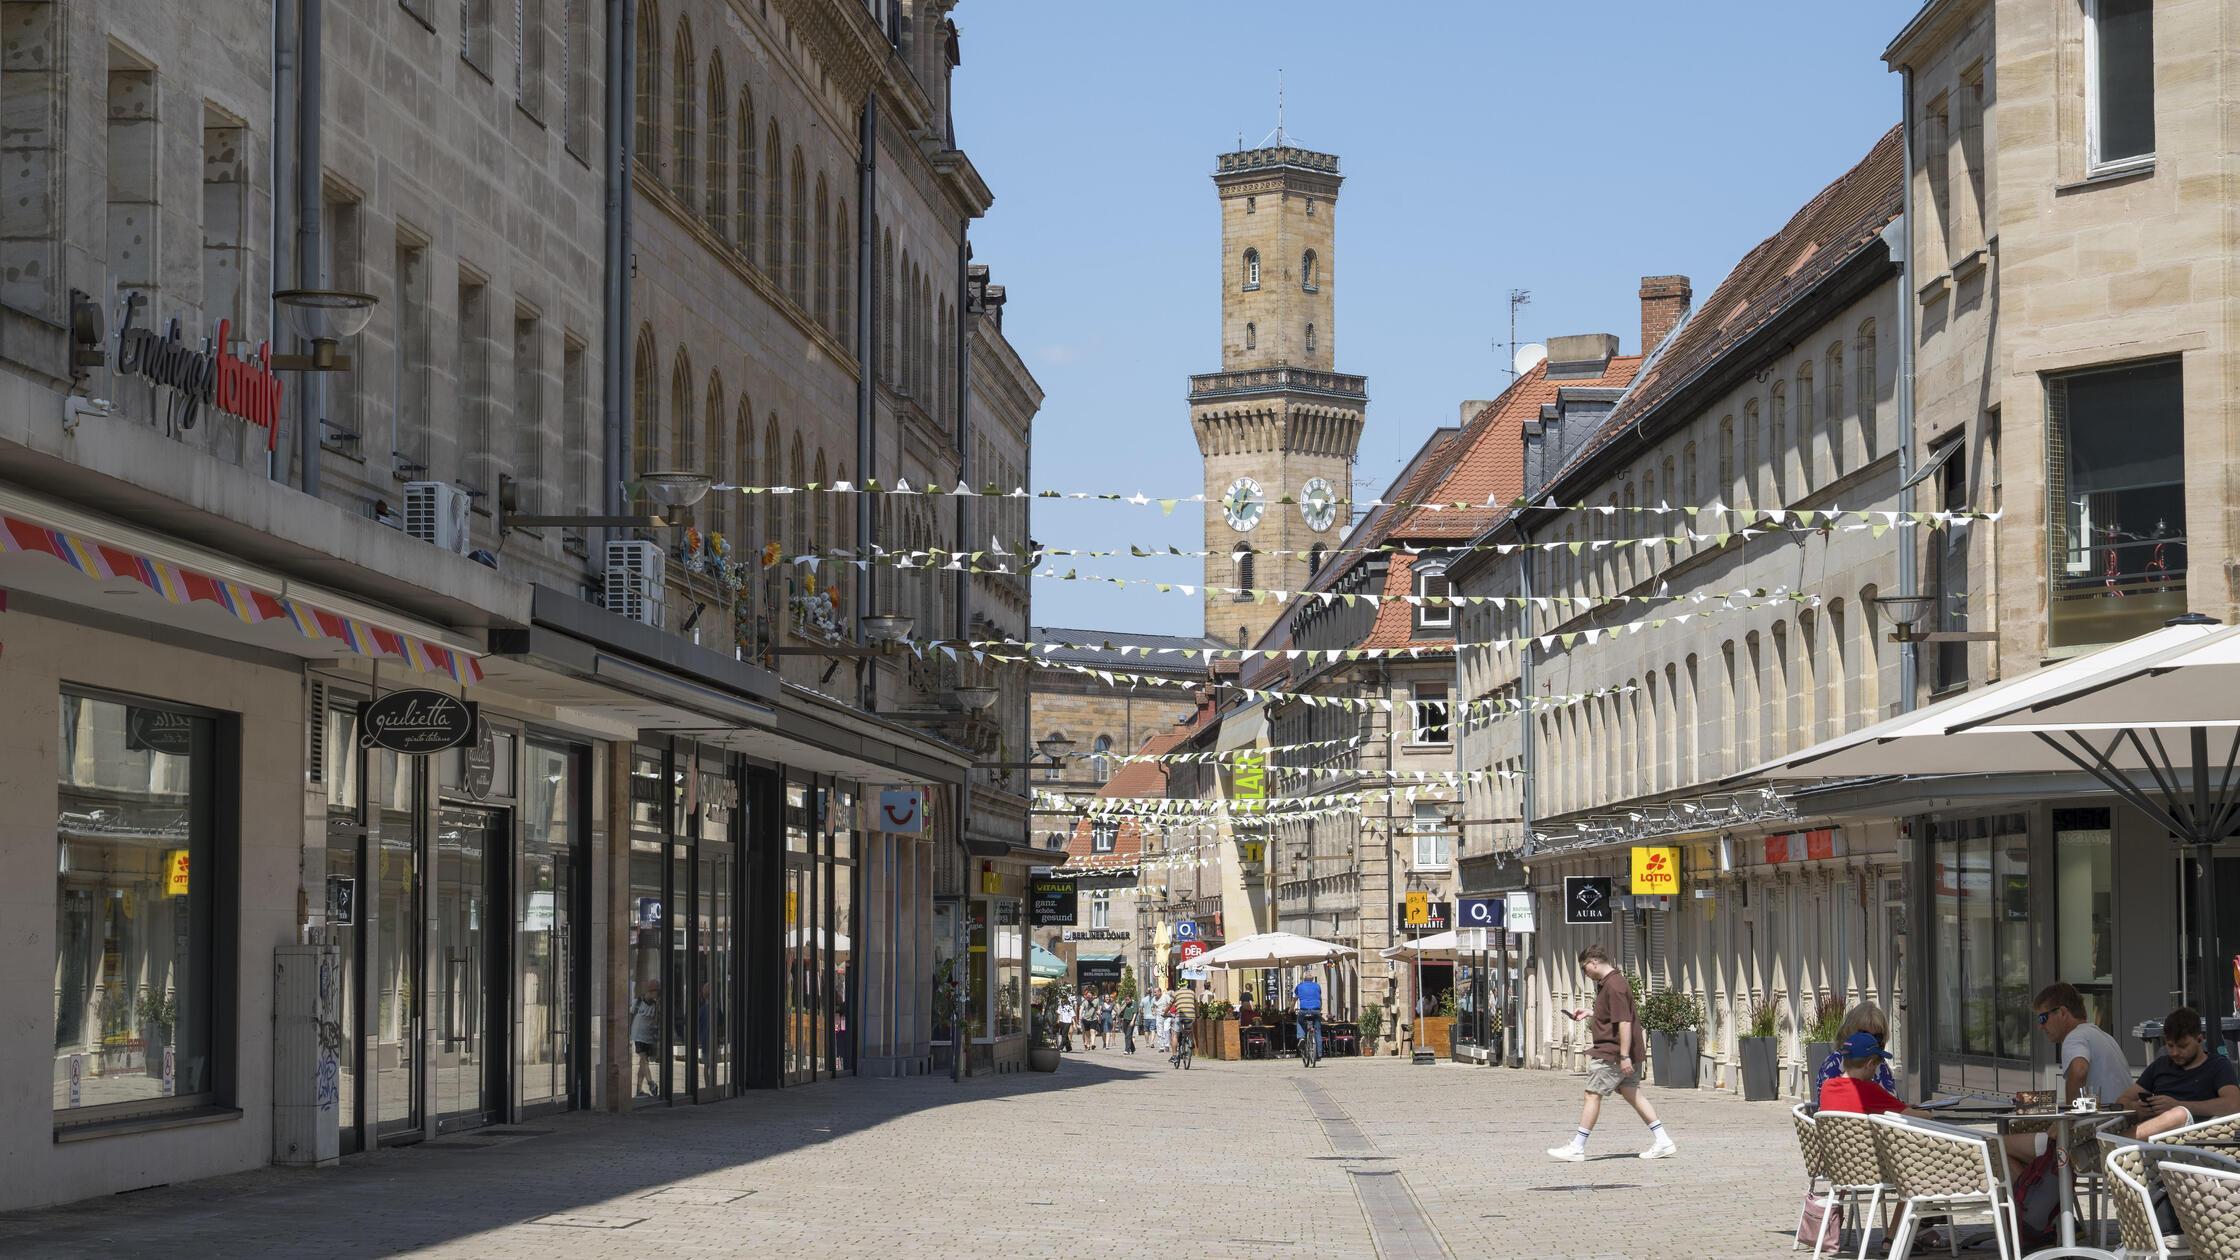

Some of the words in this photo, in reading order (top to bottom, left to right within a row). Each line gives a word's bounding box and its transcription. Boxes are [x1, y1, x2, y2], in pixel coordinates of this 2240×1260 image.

[216, 318, 284, 451] family
[1640, 874, 1672, 882] LOTTO
[1035, 900, 1057, 908] ganz.
[1576, 909, 1603, 917] AURA
[1041, 914, 1073, 923] gesund
[1404, 920, 1444, 928] RISORANTE
[1072, 931, 1104, 940] BERLINER
[1184, 947, 1202, 956] DER
